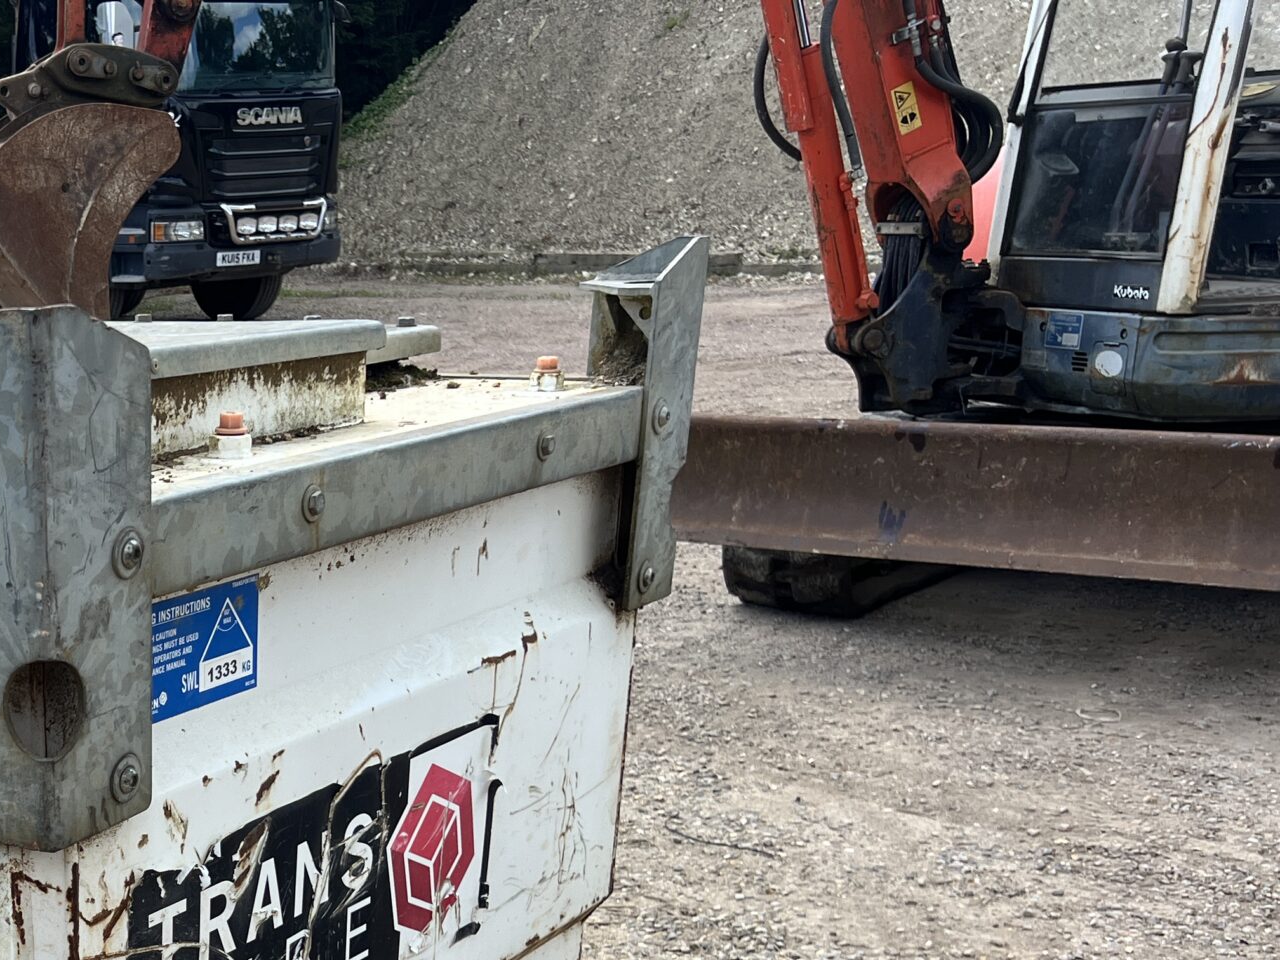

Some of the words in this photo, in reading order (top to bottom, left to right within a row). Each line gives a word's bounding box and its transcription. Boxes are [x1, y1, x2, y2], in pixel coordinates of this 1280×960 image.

[236, 107, 303, 126] SCANIA
[1113, 284, 1150, 300] Kubota
[158, 597, 210, 622] INSTRUCTIONS
[155, 628, 177, 642] CAUTION
[163, 639, 178, 651] MUST
[178, 635, 186, 646] BE
[185, 632, 200, 643] USED
[153, 648, 182, 665] OPERATORS
[182, 645, 193, 656] AND
[165, 658, 187, 672] MANUAL
[181, 670, 199, 694] SWL
[207, 659, 238, 683] 1333
[241, 660, 252, 673] KG
